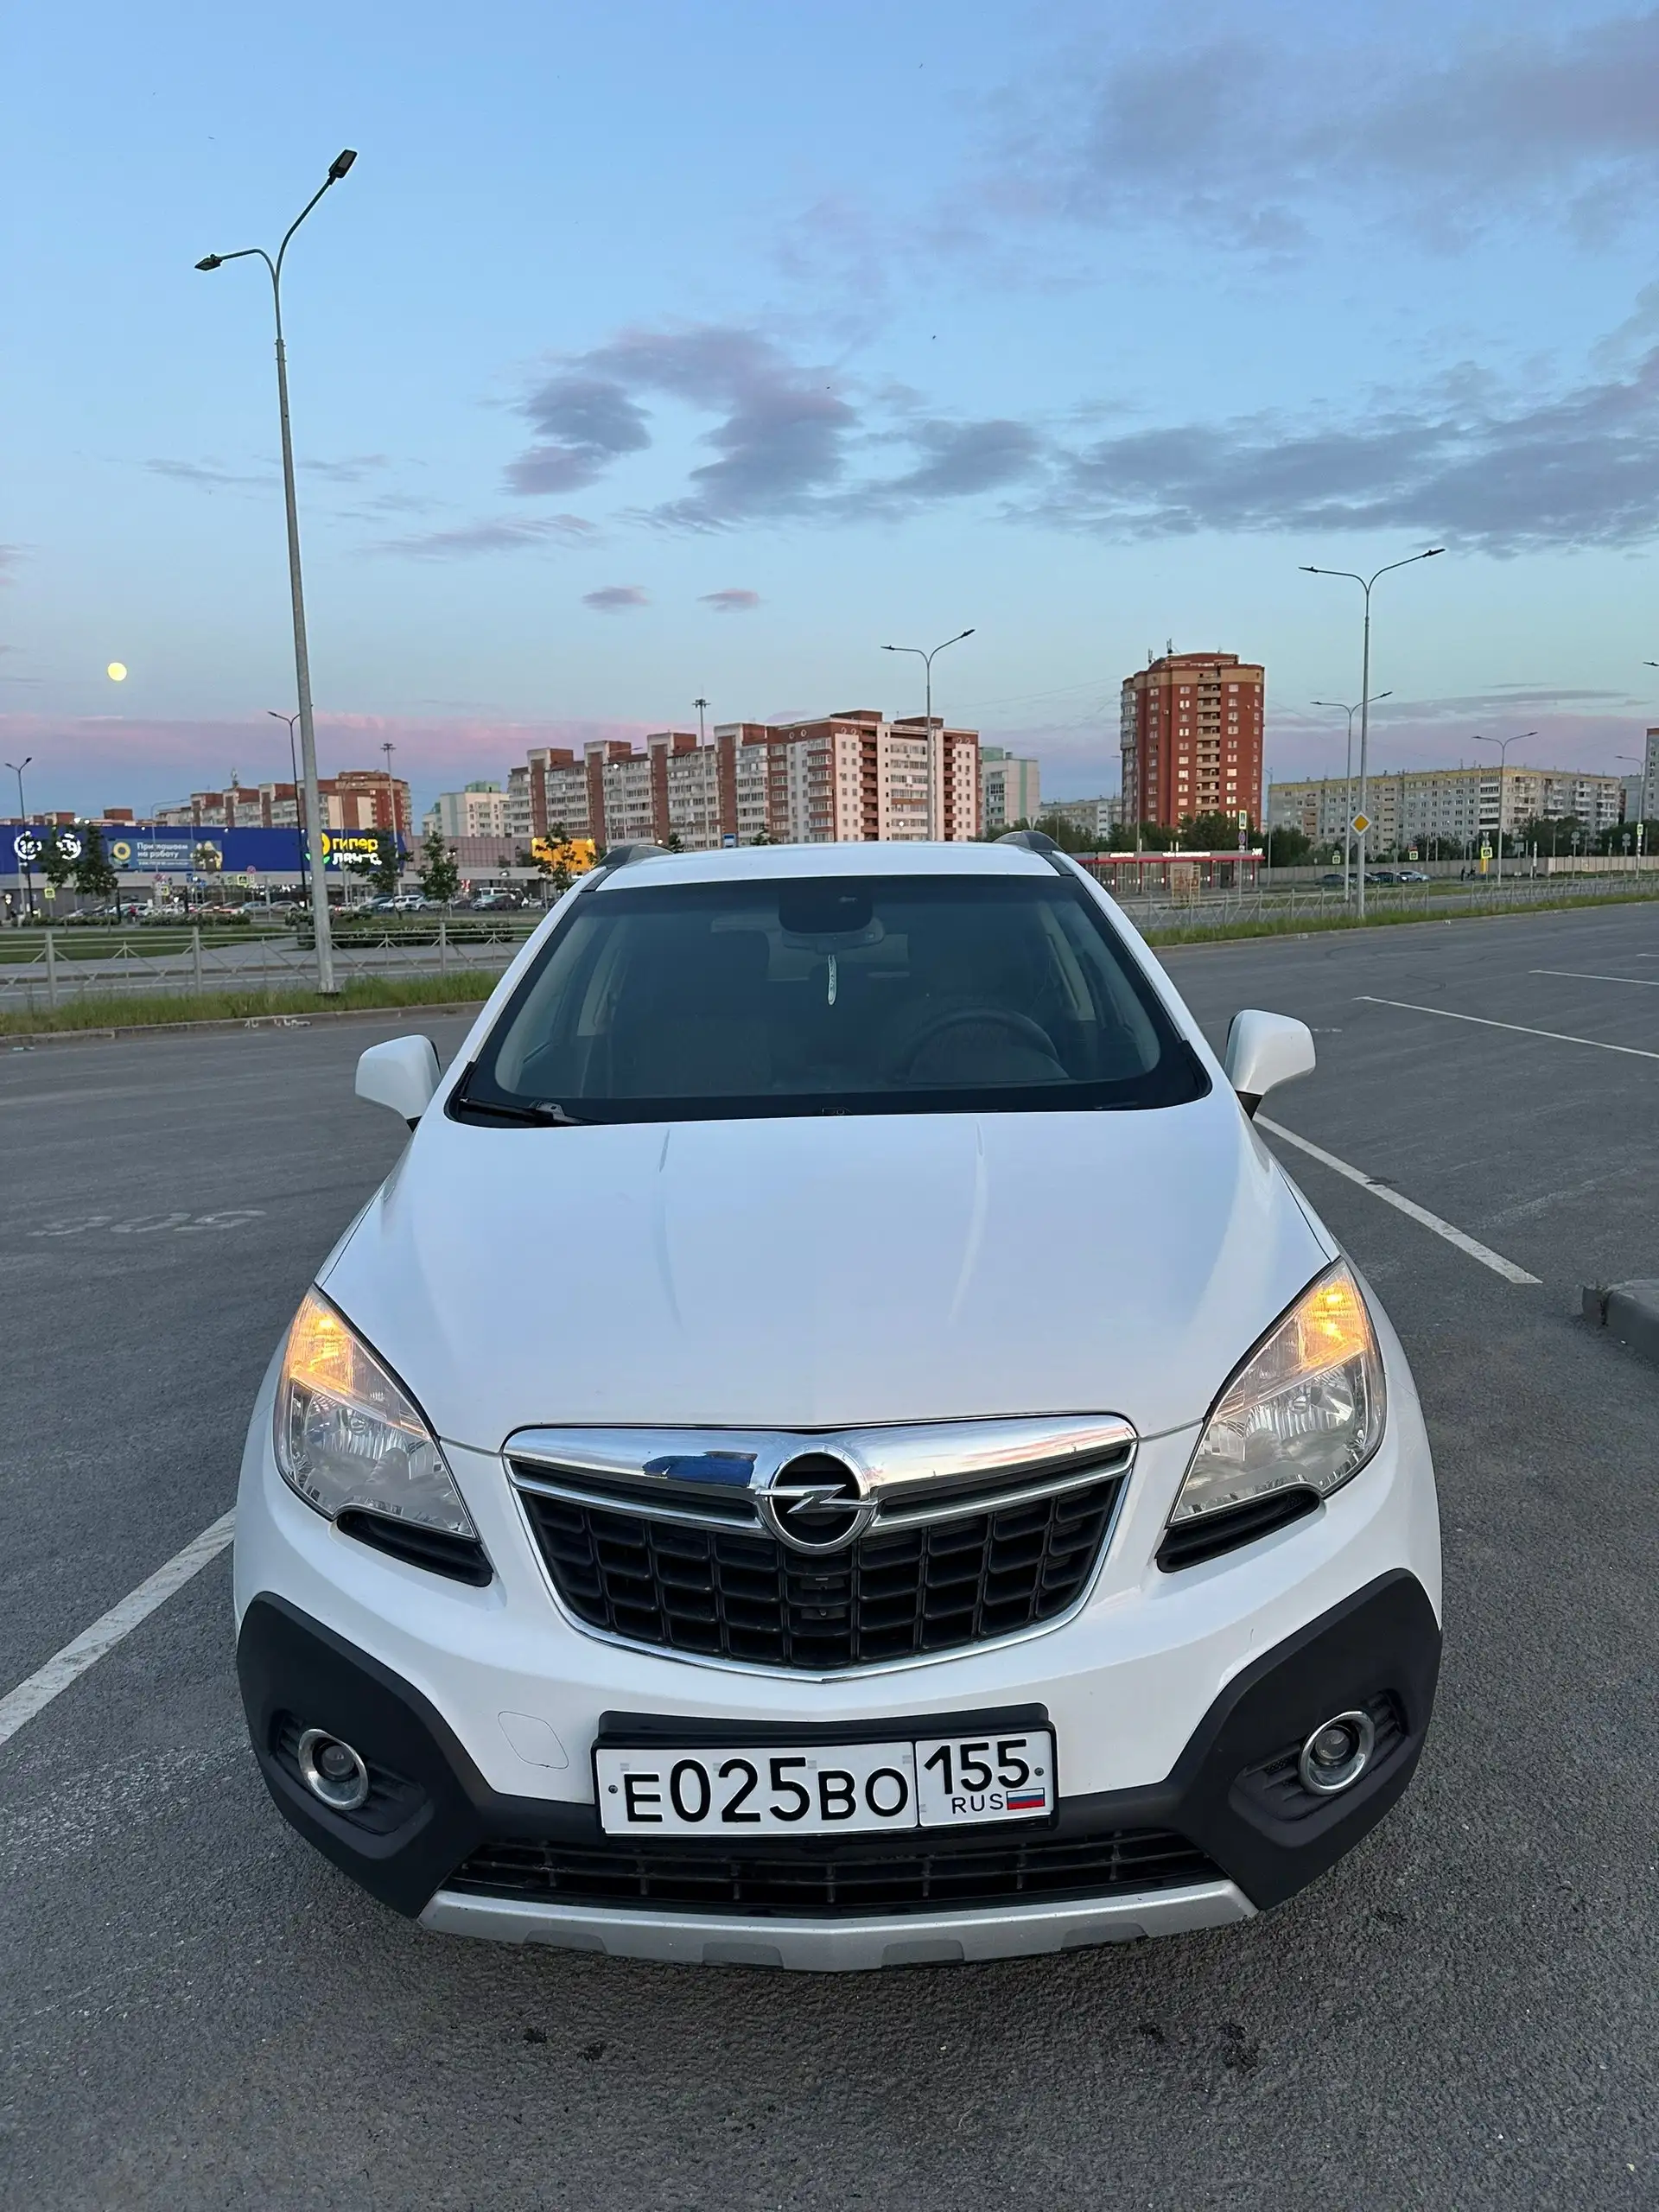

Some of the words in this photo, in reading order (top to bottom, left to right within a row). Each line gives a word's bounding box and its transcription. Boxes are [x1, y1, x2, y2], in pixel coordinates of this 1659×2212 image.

[137, 842, 188, 850] Прилашаем
[333, 838, 378, 852] гипер
[924, 1738, 1030, 1795] 155
[951, 1794, 1004, 1815] RUS
